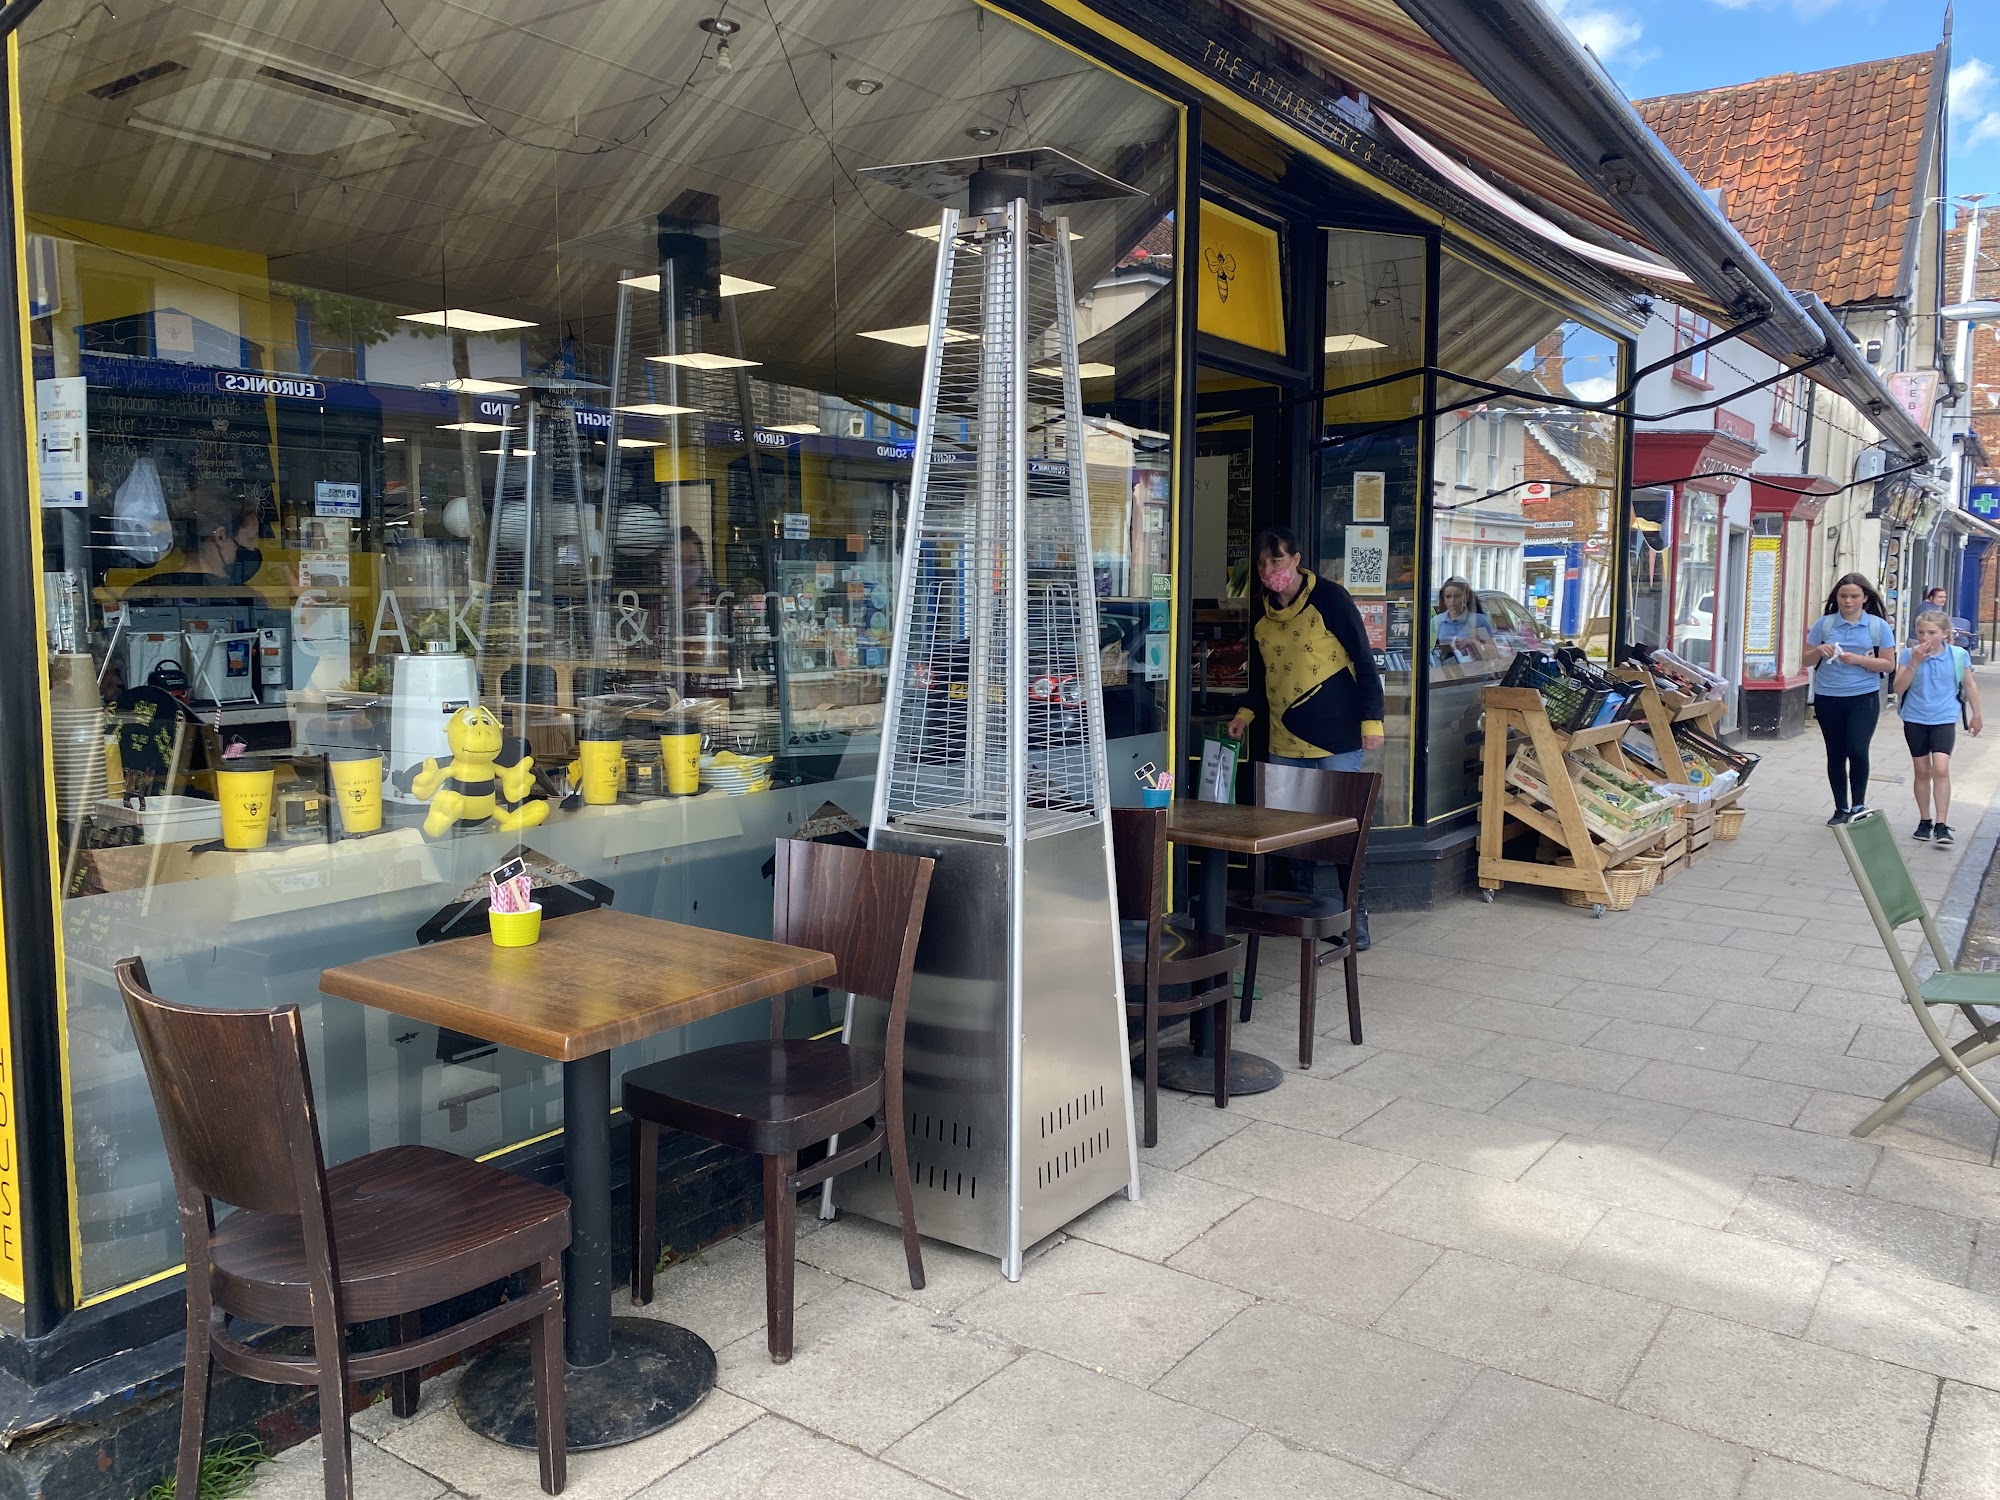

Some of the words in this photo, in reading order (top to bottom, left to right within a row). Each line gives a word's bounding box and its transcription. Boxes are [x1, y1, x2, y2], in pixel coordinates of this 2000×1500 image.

[1204, 39, 1242, 79] THE
[1248, 71, 1316, 124] APIARY
[1321, 113, 1362, 153] CAKE
[1364, 144, 1376, 163] &
[95, 368, 122, 388] Flat
[123, 368, 154, 391] White
[182, 394, 201, 416] Hot
[100, 413, 138, 432] Filter
[145, 415, 180, 431] 2.25
[100, 443, 138, 459] Mocha
[1153, 576, 1164, 584] FREE
[293, 588, 543, 657] CAKE
[615, 589, 654, 647] &
